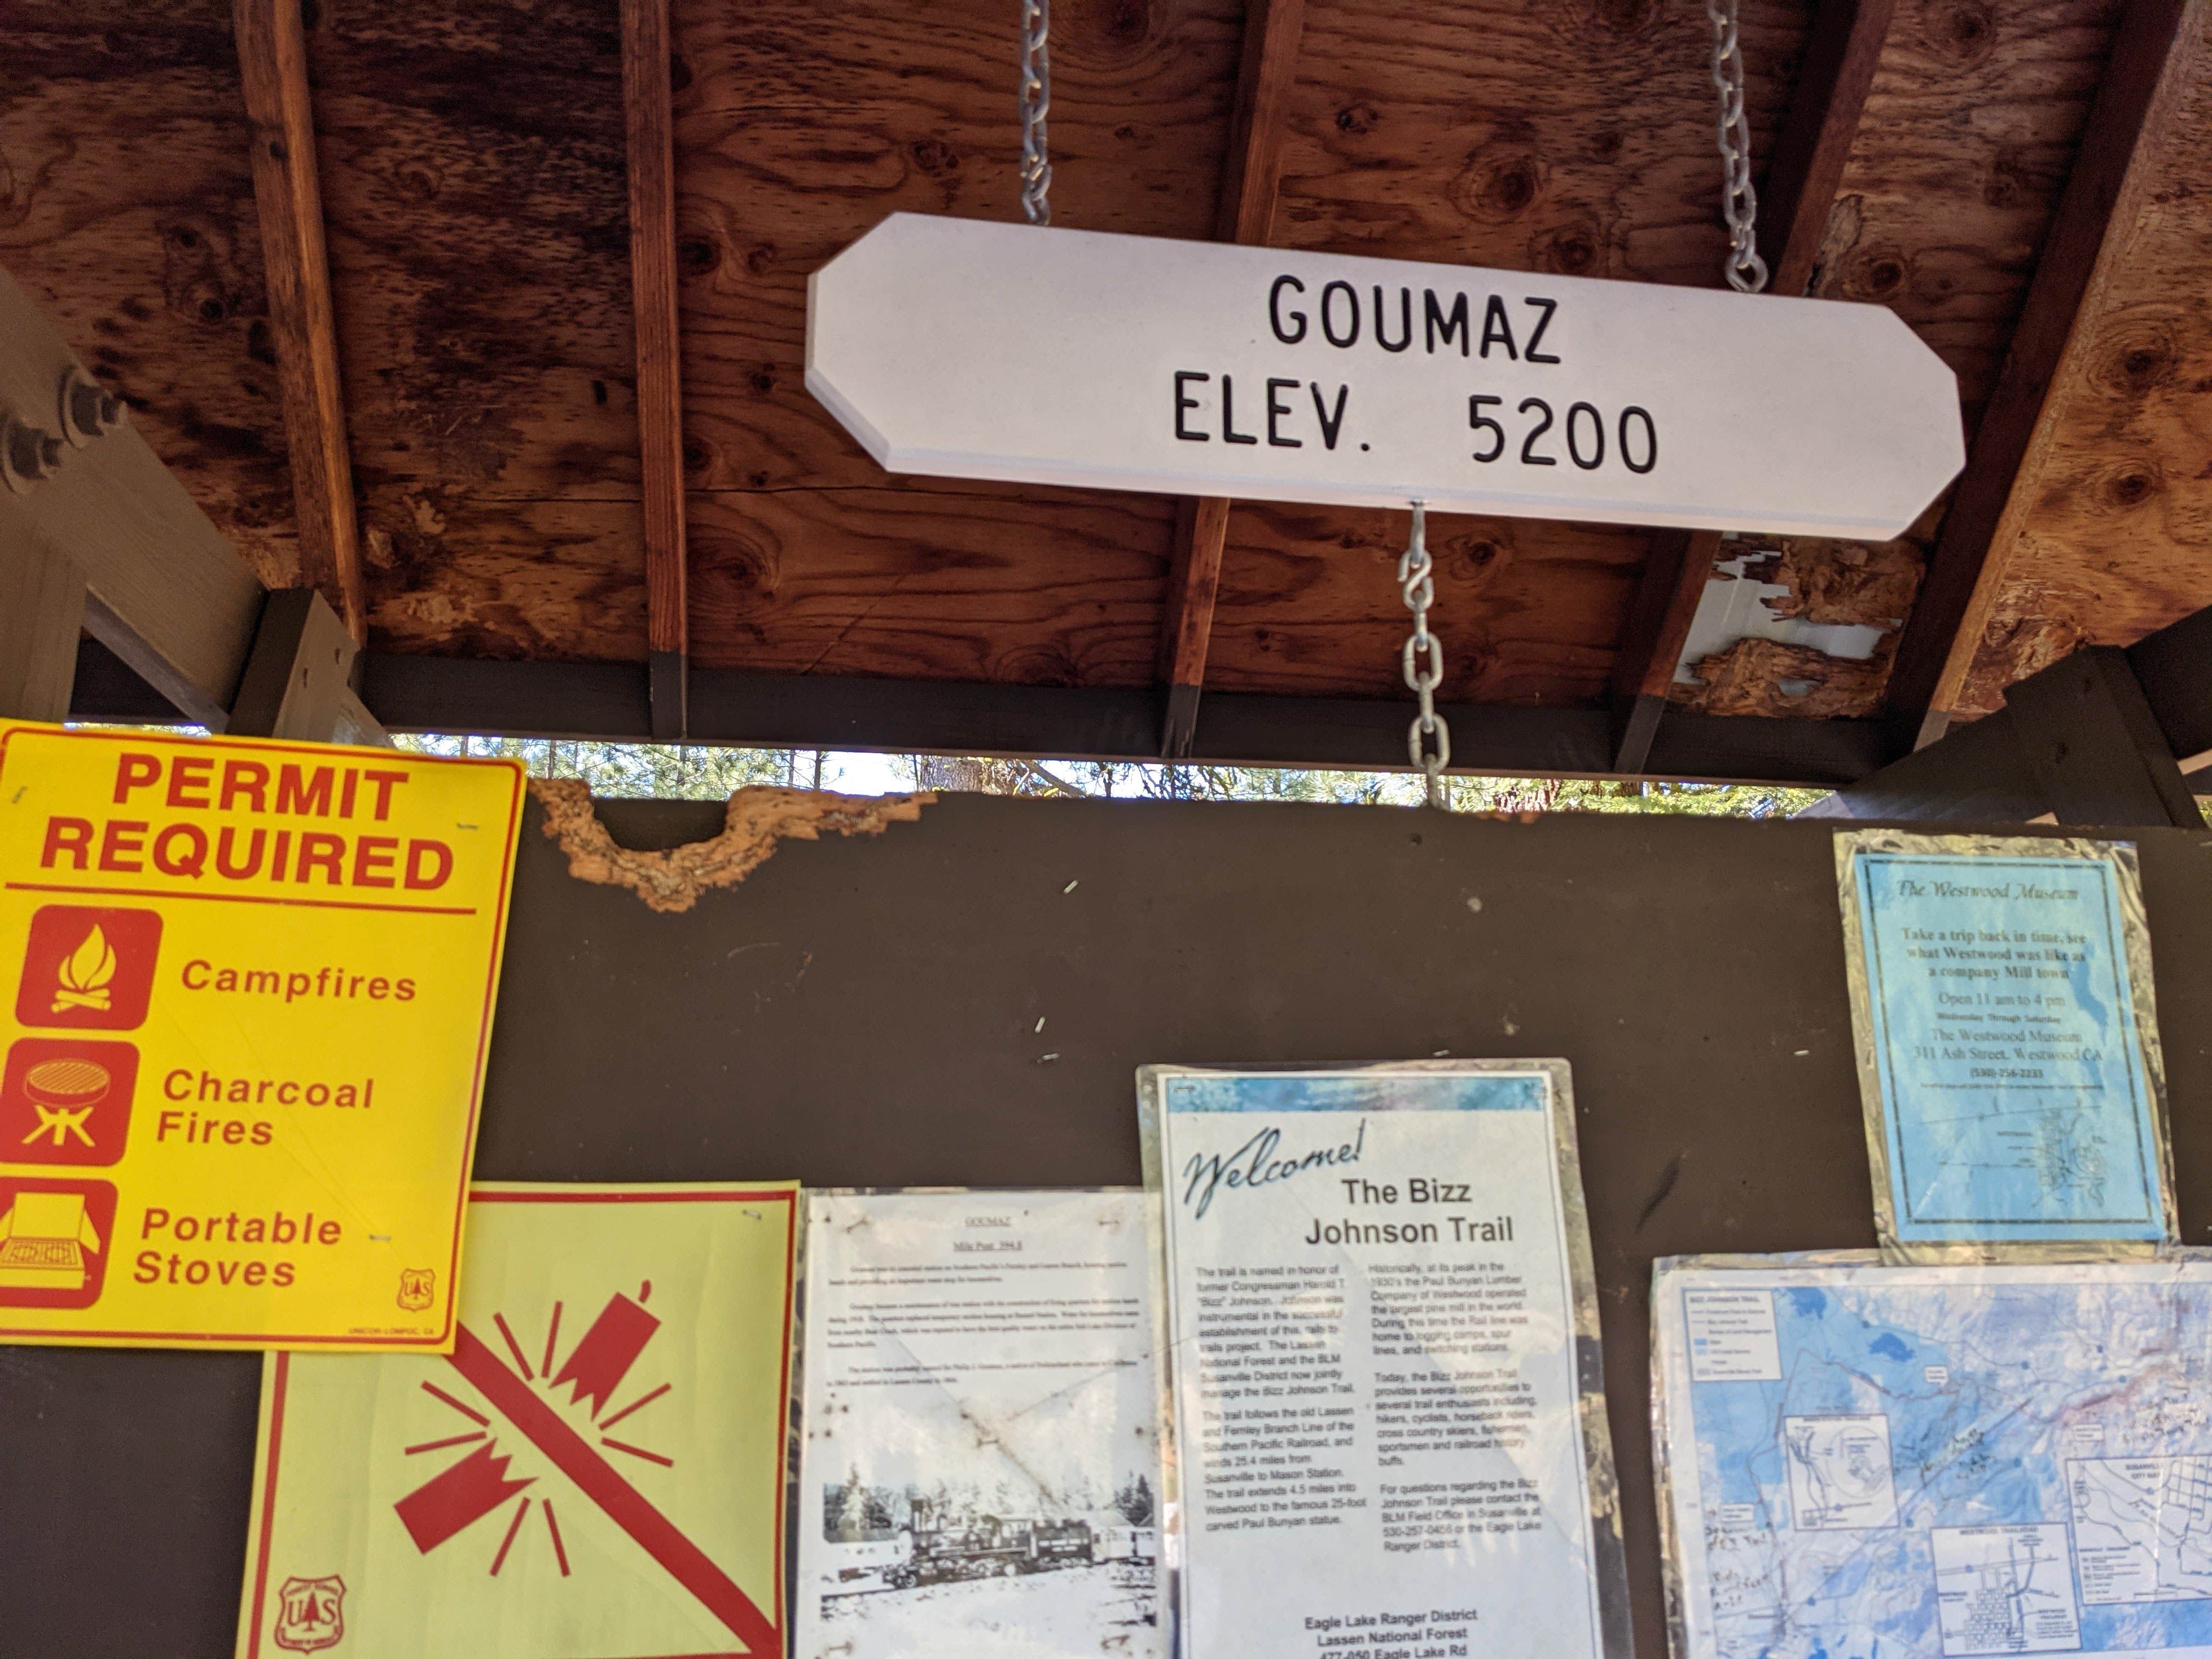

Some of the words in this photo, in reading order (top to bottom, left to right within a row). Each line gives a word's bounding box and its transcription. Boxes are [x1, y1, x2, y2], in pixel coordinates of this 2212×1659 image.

[1268, 274, 1561, 364] GOUMAZ
[1174, 370, 1371, 453] ELEV.
[1469, 394, 1657, 474] 5200
[112, 752, 410, 822] PERMIT
[40, 816, 454, 891] REQUIRED
[1897, 880, 1926, 896] The
[1930, 881, 2010, 898] Westwood
[2013, 883, 2079, 900] Museum
[1900, 927, 1935, 940] Take
[1938, 931, 1946, 941] a
[1950, 929, 1974, 945] trip
[1978, 930, 2011, 942] back
[2013, 930, 2027, 942] in
[2030, 930, 2064, 945] time,
[1906, 946, 1939, 958] what
[1943, 947, 2012, 960] Westwood
[2015, 950, 2041, 960] was
[2044, 948, 2069, 961] like
[2072, 952, 2086, 962] as
[181, 959, 417, 1003] Campfires
[1928, 967, 1937, 977] a
[1939, 967, 2000, 980] company
[2004, 966, 2033, 978] Mill
[2036, 967, 2069, 979] town
[1938, 992, 1973, 1007] Open
[1977, 992, 1990, 1005] 11
[2017, 995, 2031, 1005] to
[2034, 994, 2042, 1005] 4
[2045, 996, 2066, 1009] pm
[1932, 1028, 1955, 1042] The
[1958, 1028, 2027, 1042] Westwood
[2028, 1030, 2084, 1043] Museum
[1942, 1047, 1967, 1060] Ash
[2012, 1047, 2080, 1061] Westwood
[2081, 1048, 2103, 1062] CA
[163, 1069, 375, 1109] Charcoal
[157, 1111, 274, 1146] Fires
[1183, 1118, 1367, 1220] Welcome!
[1341, 1178, 1398, 1204] The
[1409, 1178, 1474, 1204] Bizz
[140, 1207, 343, 1245] Portable
[1305, 1218, 1438, 1245] Johnson
[1447, 1216, 1514, 1242] Trail
[133, 1250, 296, 1286] Stoves
[1244, 1356, 1275, 1365] Forest
[1278, 1356, 1297, 1365] and
[1299, 1356, 1315, 1364] the
[1318, 1354, 1341, 1364] BLM
[1244, 1388, 1260, 1397] the
[1262, 1386, 1284, 1396] Bizz
[1286, 1386, 1328, 1395] Johnson
[1264, 1424, 1299, 1434] Branch
[1302, 1424, 1324, 1432] Line
[1326, 1422, 1336, 1432] of
[1338, 1423, 1355, 1431] the
[1204, 1489, 1223, 1499] The
[1226, 1488, 1244, 1498] trail
[1248, 1487, 1287, 1497] extends
[1308, 1485, 1335, 1493] miles
[1338, 1484, 1356, 1492] into
[1380, 1484, 1397, 1493] For
[1400, 1485, 1447, 1494] questions
[1450, 1482, 1497, 1492] regarding
[1499, 1480, 1515, 1489] the
[1205, 1504, 1257, 1514] Westwood
[1260, 1504, 1269, 1512] to
[1272, 1503, 1288, 1511] the
[1291, 1501, 1328, 1510] famous
[1426, 1497, 1447, 1506] Trail
[1451, 1497, 1483, 1506] please
[1486, 1494, 1521, 1504] contact
[1524, 1493, 1539, 1502] the
[1205, 1521, 1239, 1530] carved
[1242, 1519, 1264, 1528] Paul
[1267, 1518, 1306, 1528] Bunyan
[1304, 1616, 1342, 1632] Eagle
[1346, 1614, 1376, 1628] Lake
[1380, 1612, 1427, 1627] Ranger
[1431, 1609, 1479, 1622] District
[1317, 1634, 1364, 1647] Lassen
[1369, 1629, 1423, 1644] National
[1426, 1627, 1468, 1640] Forest
[1374, 1647, 1410, 1659] Eagle
[1415, 1646, 1445, 1658] Lake
[1450, 1644, 1467, 1657] Rd
